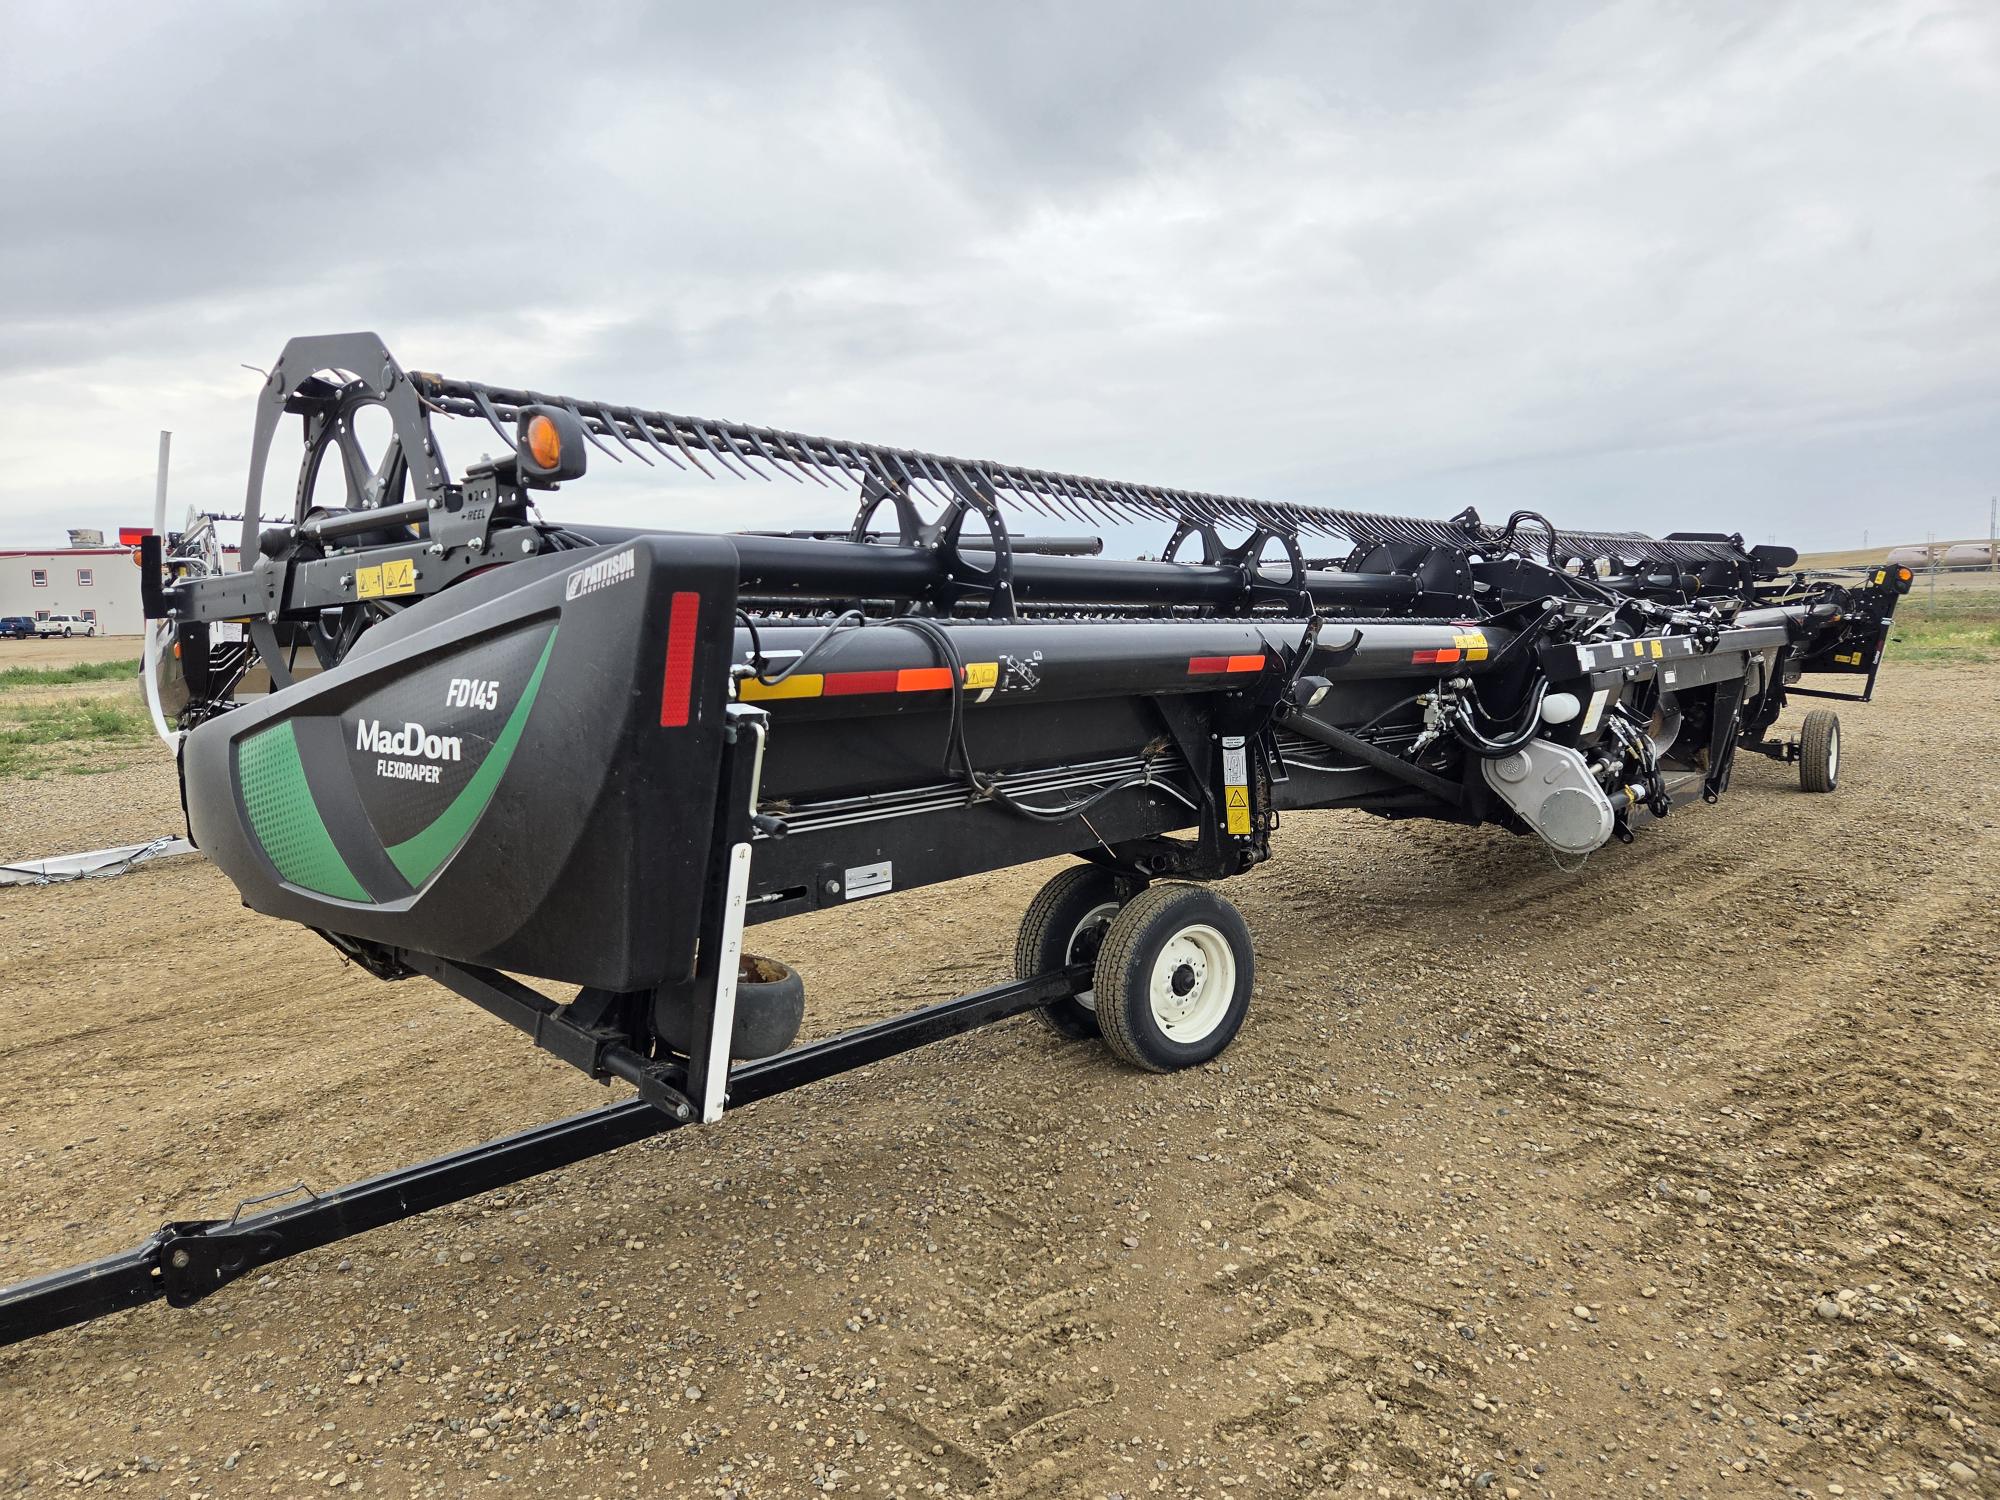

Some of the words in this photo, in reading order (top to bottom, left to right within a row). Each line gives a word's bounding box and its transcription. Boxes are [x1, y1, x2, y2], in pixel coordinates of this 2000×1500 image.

[467, 508, 485, 520] REEL
[584, 548, 635, 588] PATTISON
[582, 569, 635, 595] AGRICULTURE
[445, 678, 500, 711] FD145
[356, 718, 461, 761] MacDon
[376, 759, 440, 784] FLEXDRAPER
[739, 848, 746, 860] 4
[734, 895, 741, 907] 3
[729, 941, 736, 953] 2
